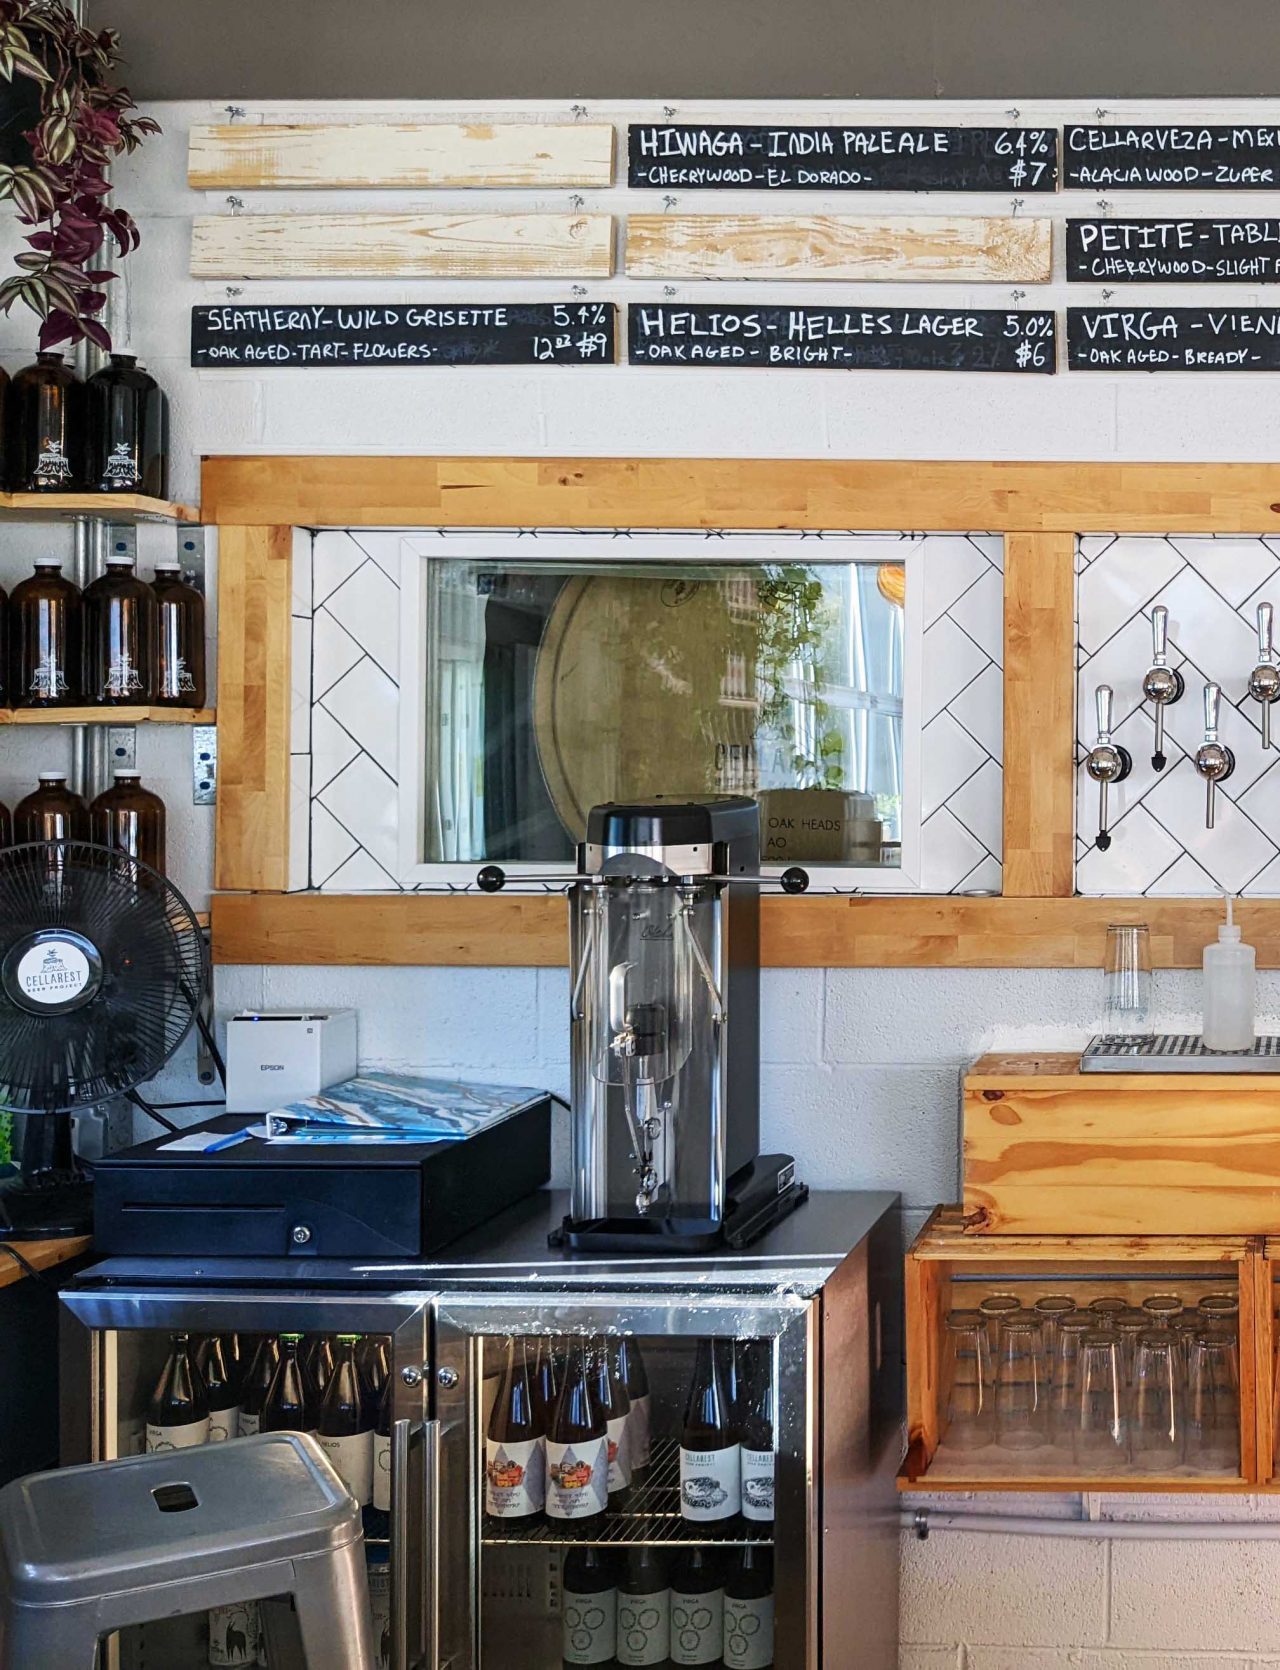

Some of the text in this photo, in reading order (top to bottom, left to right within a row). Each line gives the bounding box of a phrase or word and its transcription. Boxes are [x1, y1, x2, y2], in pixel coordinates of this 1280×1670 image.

[640, 127, 744, 158] HIWAGA
[768, 131, 834, 158] INDIA
[994, 130, 1049, 157] 6.4%
[1008, 158, 1047, 188] $7
[405, 307, 508, 328] GRISETTE
[553, 303, 606, 327] 5.4%
[788, 310, 893, 342] HELLES
[901, 313, 984, 337] LAGER
[1002, 314, 1054, 338] 5.0%
[1081, 311, 1179, 341] VIRGA
[575, 331, 608, 358] $9
[1014, 339, 1046, 368] $6
[768, 817, 841, 832] OAK HEADS
[26, 970, 81, 987] CELLAREST
